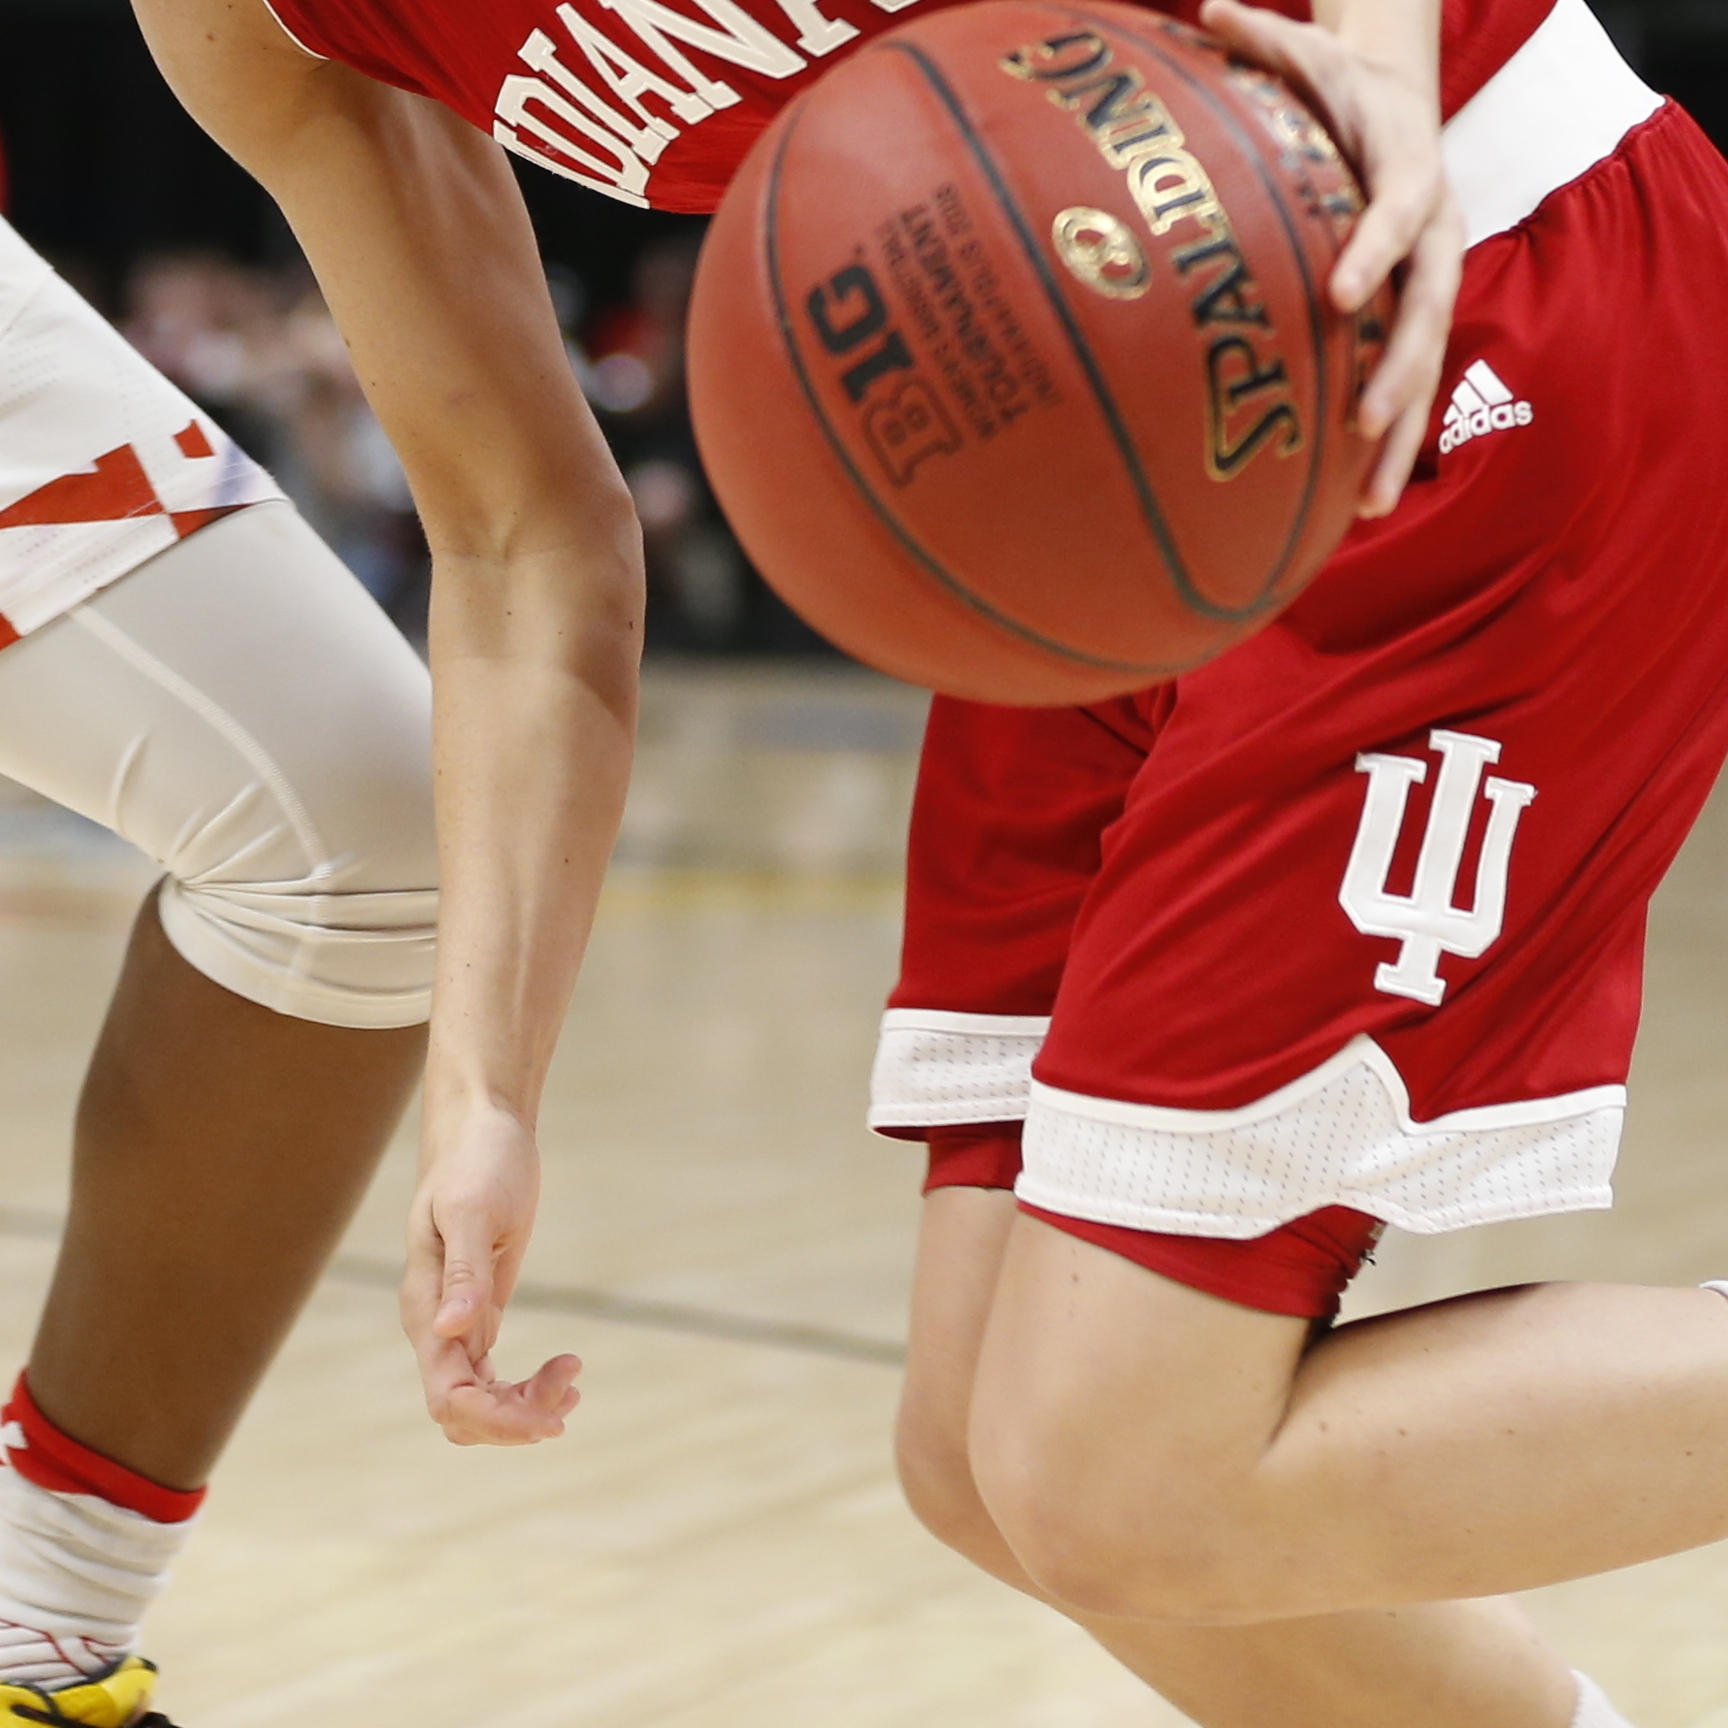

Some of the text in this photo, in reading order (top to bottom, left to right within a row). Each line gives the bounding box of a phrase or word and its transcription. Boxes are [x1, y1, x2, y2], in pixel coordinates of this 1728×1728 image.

[900, 203, 1029, 426] TOURNAMENT
[1000, 26, 1306, 482] SPALDING
[1438, 400, 1534, 455] adidas
